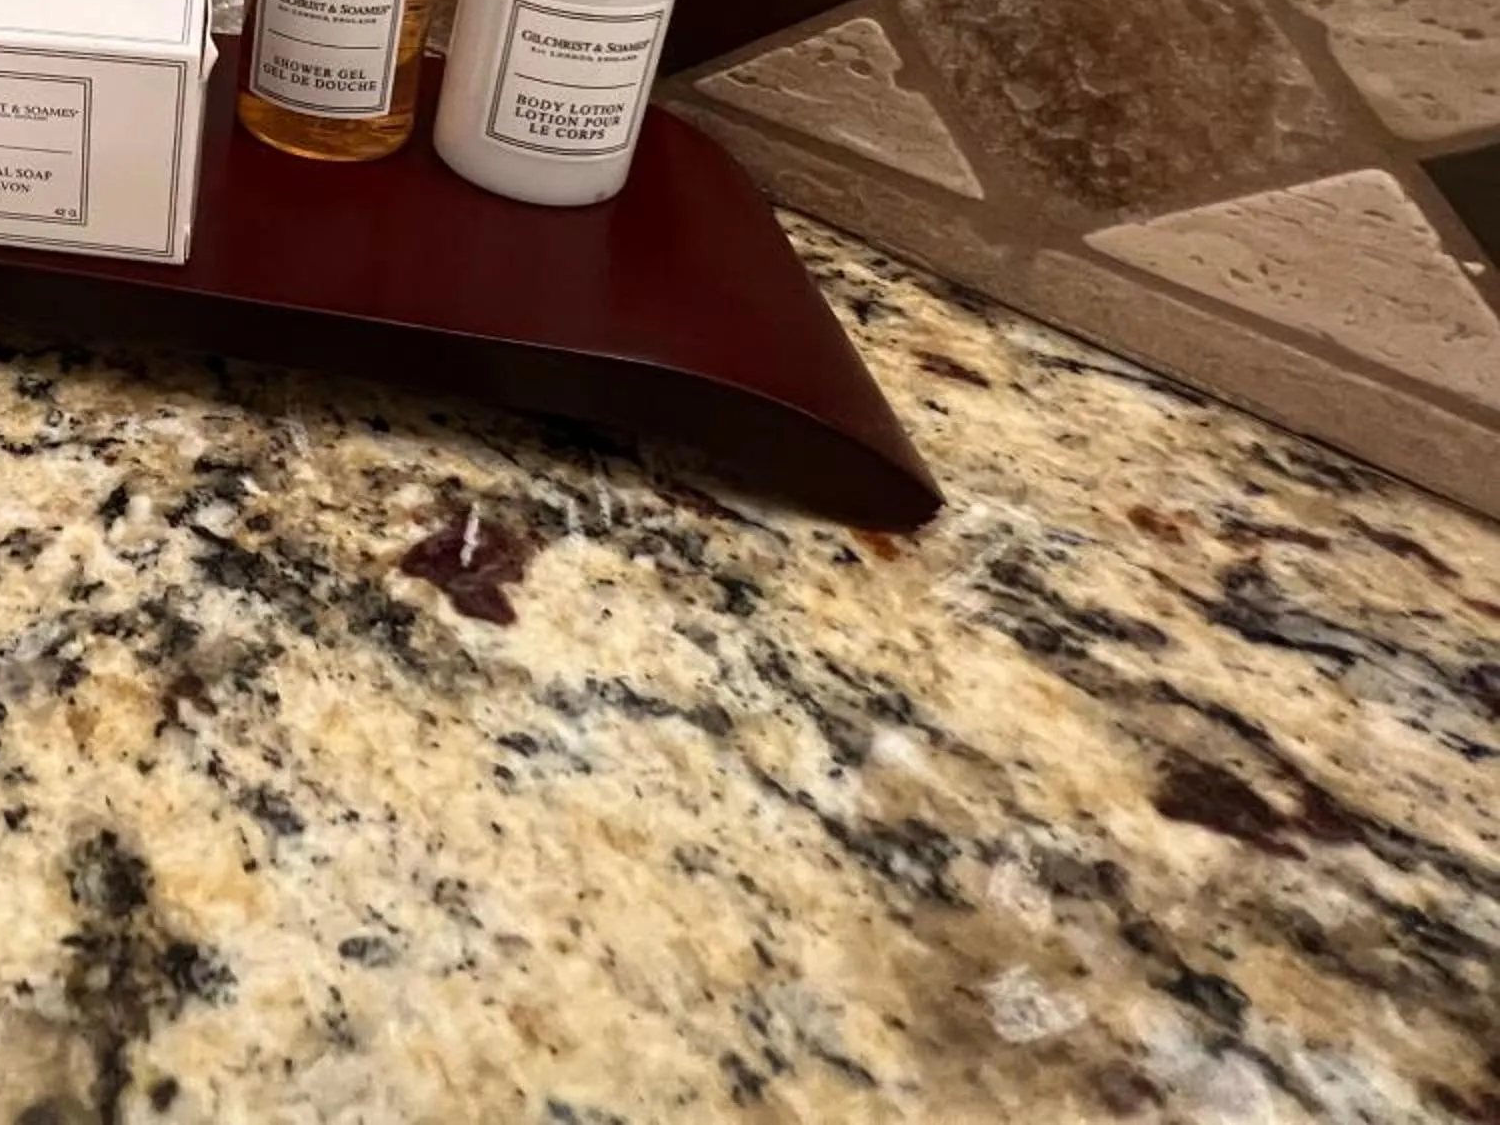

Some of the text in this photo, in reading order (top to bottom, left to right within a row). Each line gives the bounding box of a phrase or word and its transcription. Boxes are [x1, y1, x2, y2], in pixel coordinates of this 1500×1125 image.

[328, 5, 338, 14] &
[521, 29, 592, 51] GILCHRIST
[593, 43, 603, 53] &
[263, 63, 378, 92] GEL DE DOUCHE
[273, 55, 367, 80] SHOWER GEL
[11, 104, 20, 114] &
[517, 94, 626, 116] BODY LOTION
[515, 106, 621, 128] LOTION POUR
[529, 123, 605, 140] LE CORPS
[15, 168, 53, 180] SOAP
